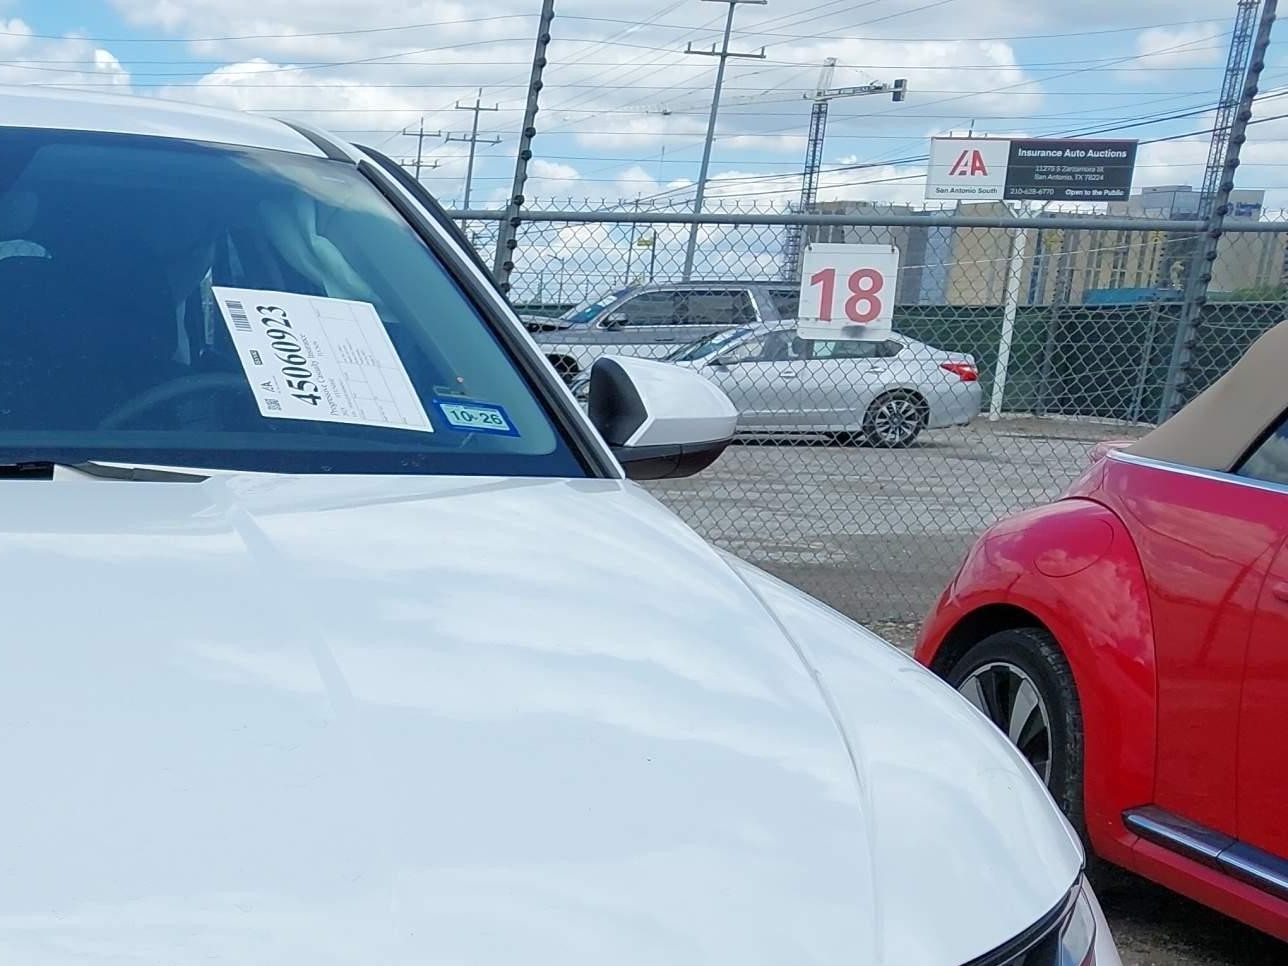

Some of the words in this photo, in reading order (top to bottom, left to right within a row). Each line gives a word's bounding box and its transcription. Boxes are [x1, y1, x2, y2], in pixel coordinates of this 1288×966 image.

[1018, 148, 1063, 158] Insurance
[1063, 149, 1086, 158] Auto
[1086, 149, 1128, 159] Auctions
[1034, 173, 1047, 181] San
[1065, 188, 1083, 197] Open
[1103, 189, 1125, 197] Public
[810, 267, 884, 324] 18
[255, 305, 323, 407] 45060923
